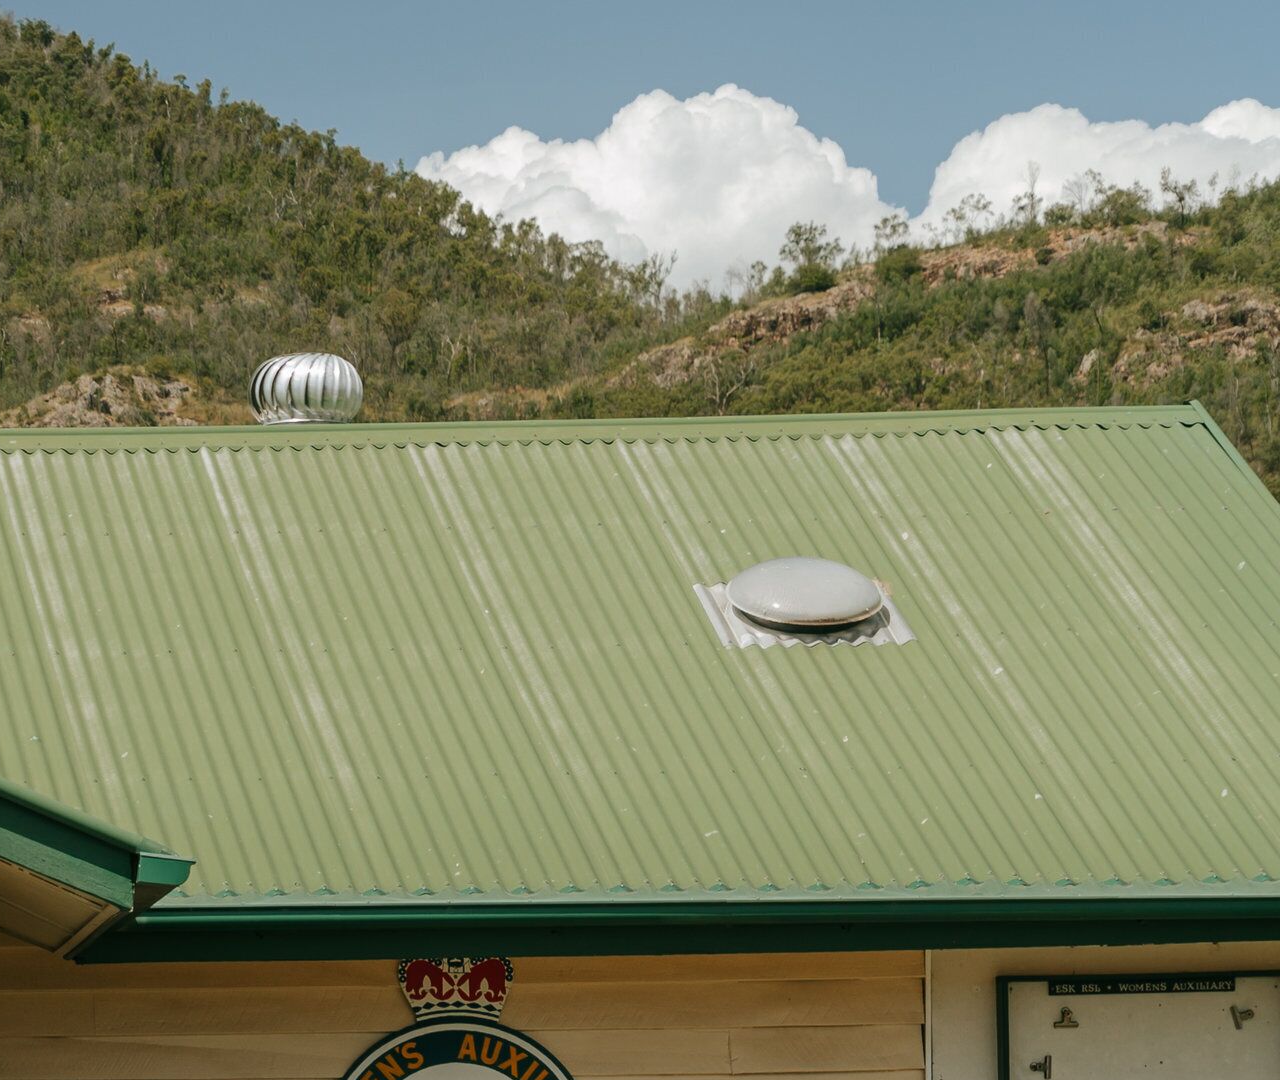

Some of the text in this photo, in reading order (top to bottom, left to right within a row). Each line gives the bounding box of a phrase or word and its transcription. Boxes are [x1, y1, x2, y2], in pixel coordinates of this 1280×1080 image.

[1055, 980, 1232, 993] ESK RSL WOMENS AUXILIARY
